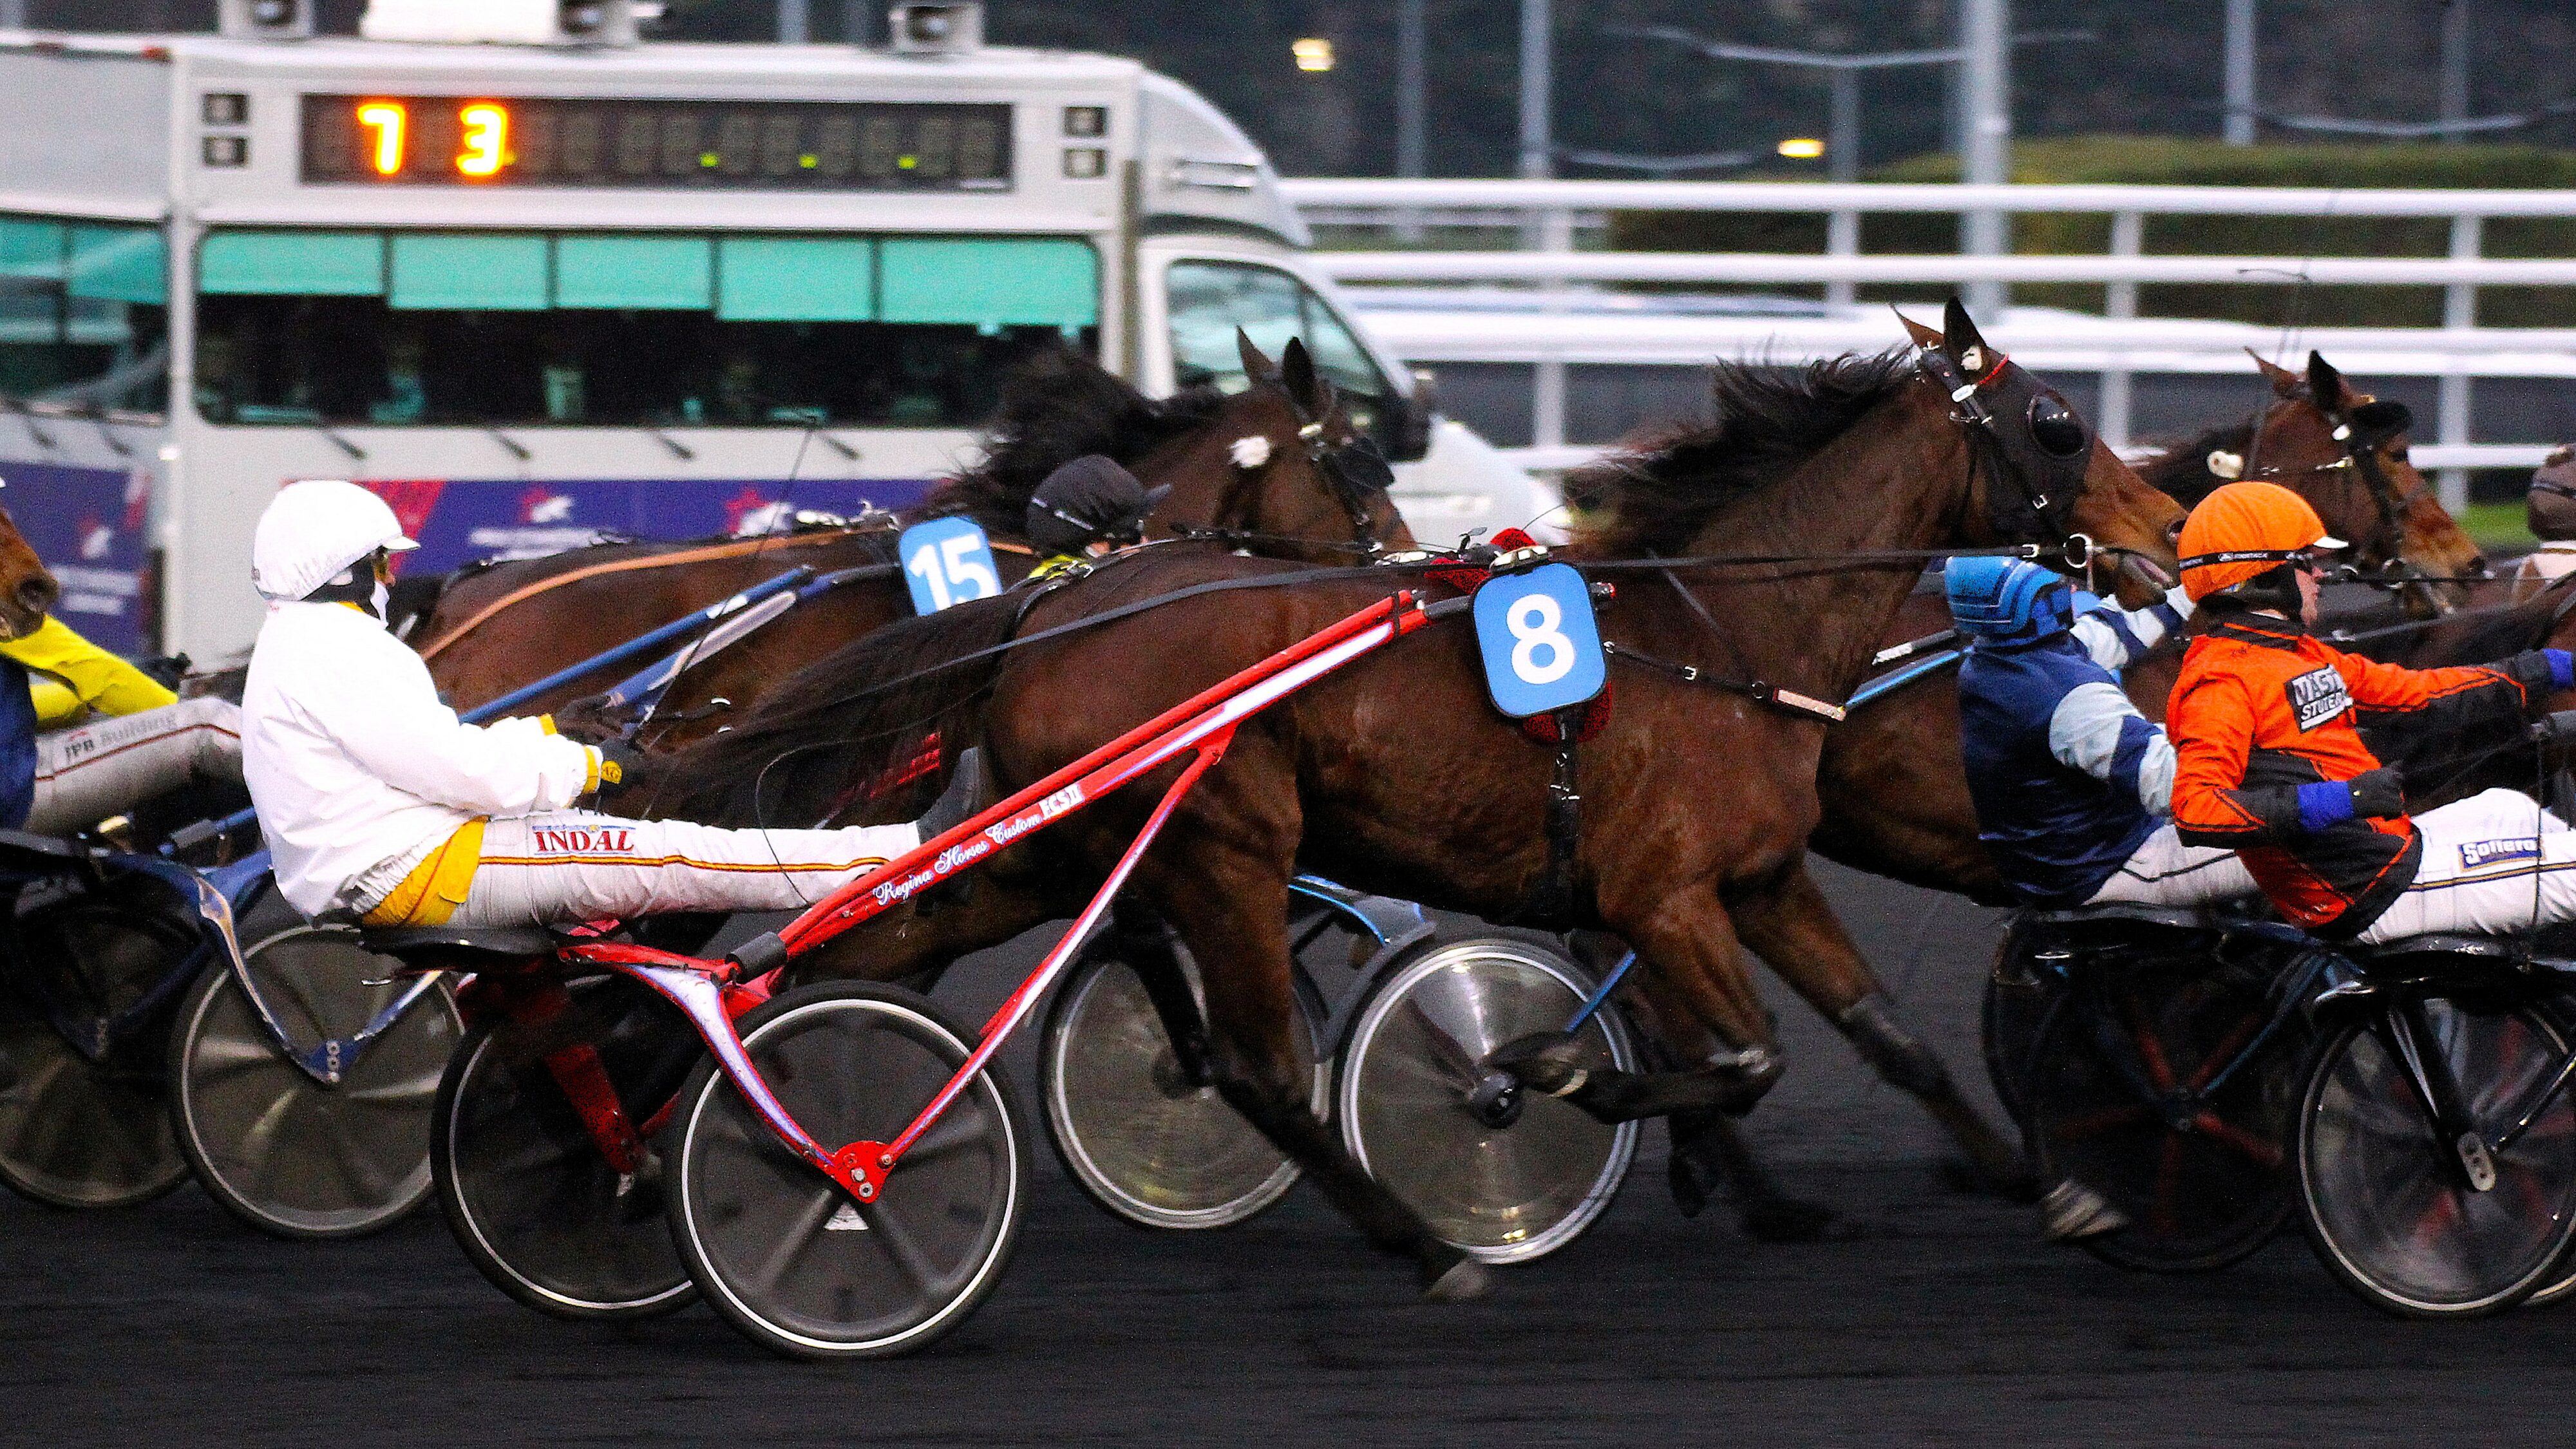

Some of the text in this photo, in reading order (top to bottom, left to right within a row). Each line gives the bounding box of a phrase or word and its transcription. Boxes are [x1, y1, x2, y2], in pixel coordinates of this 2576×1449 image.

[358, 104, 507, 176] 7 3
[909, 534, 997, 611] 15
[1506, 594, 1576, 685] 8
[533, 829, 634, 852] INDAL
[873, 870, 933, 906] Regina
[934, 840, 990, 875] Horses
[985, 814, 1043, 844] Custom
